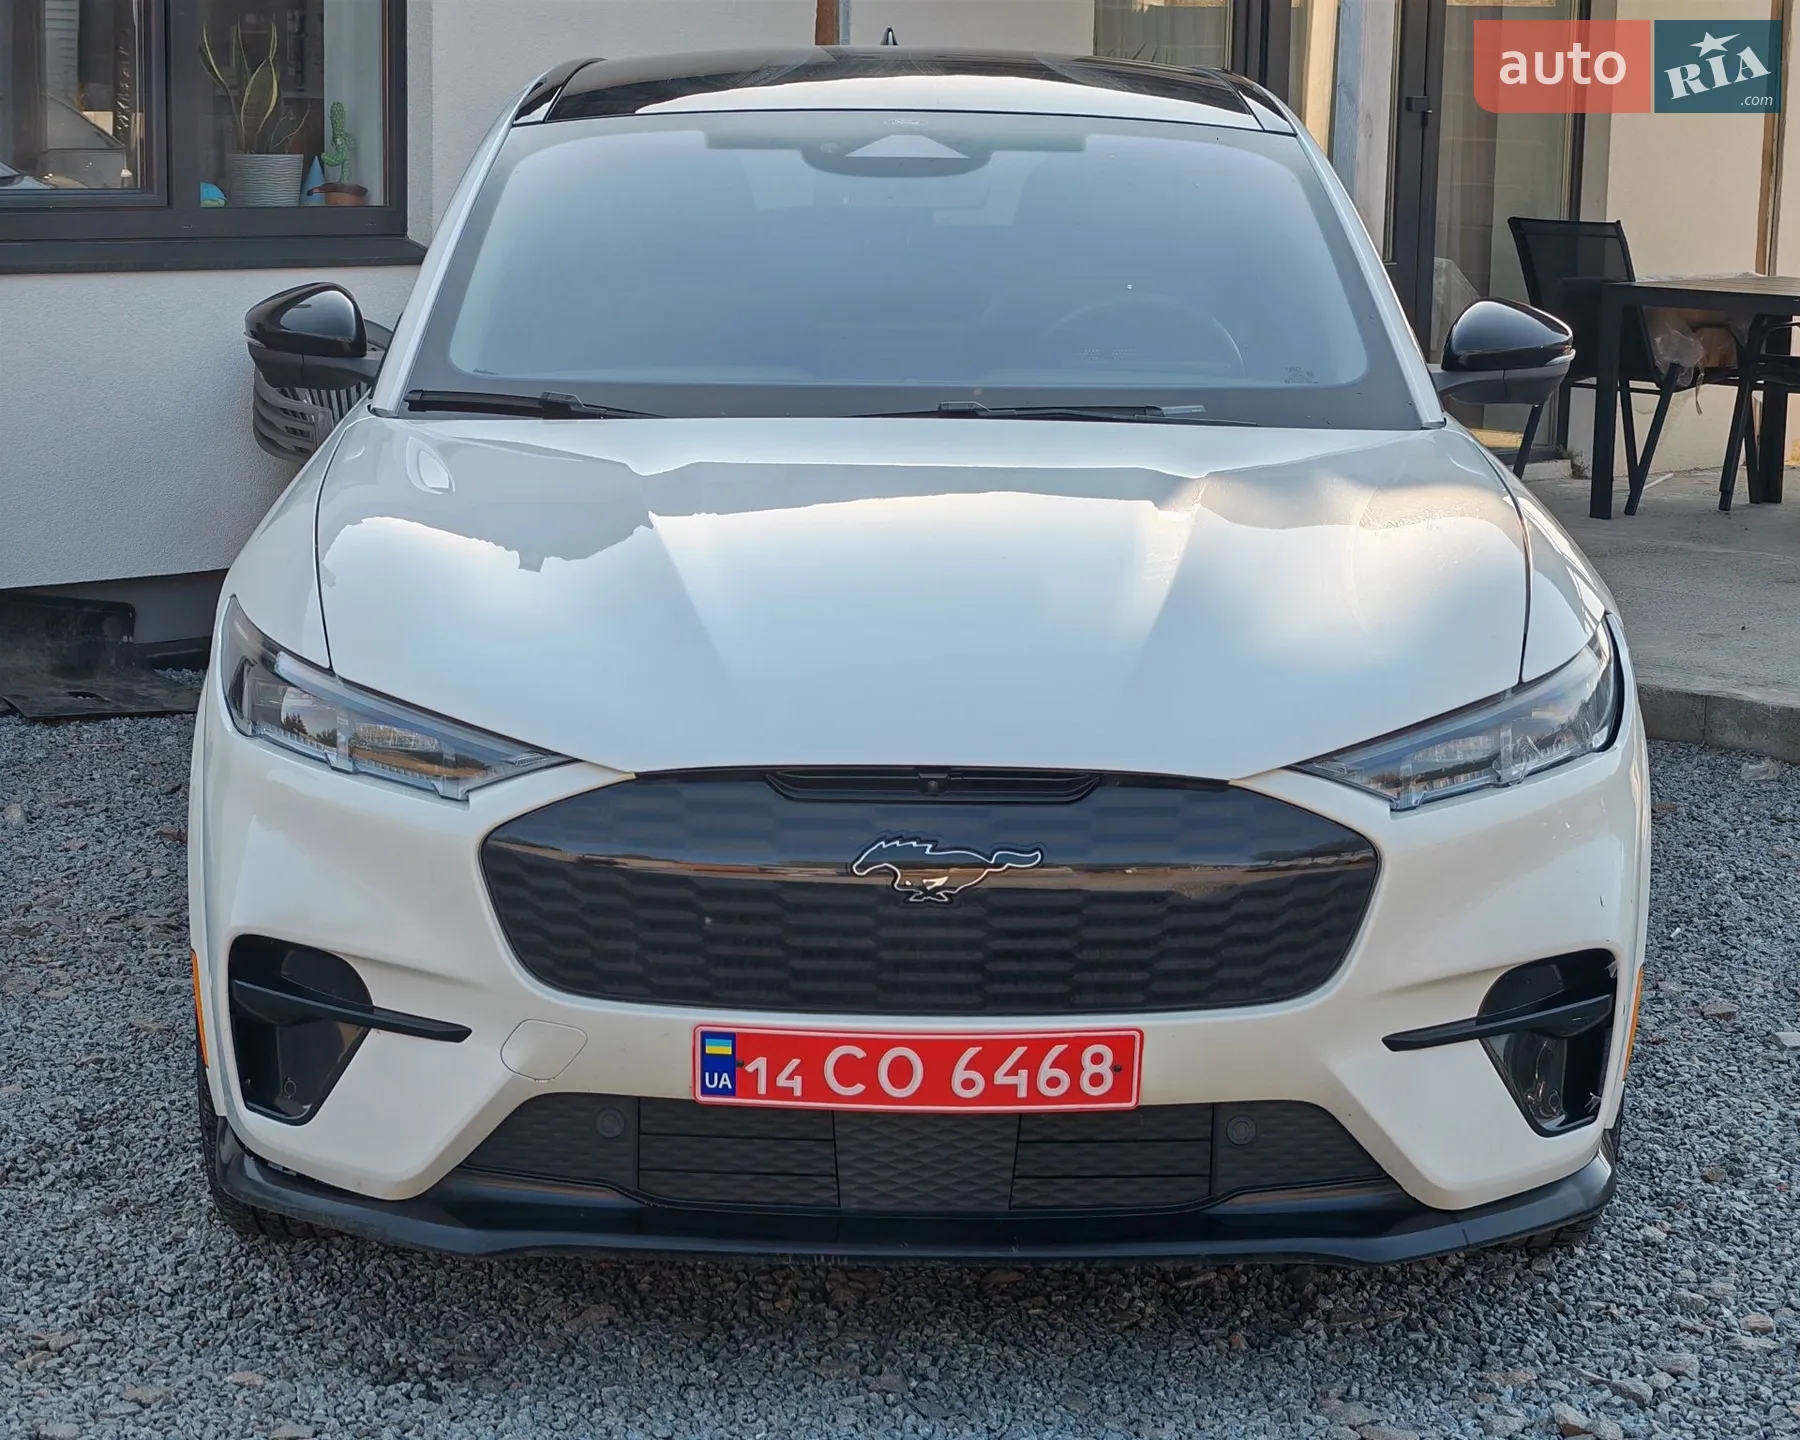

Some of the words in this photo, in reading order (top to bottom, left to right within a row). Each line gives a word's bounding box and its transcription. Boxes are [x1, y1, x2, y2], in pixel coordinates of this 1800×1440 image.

[705, 1072, 732, 1089] UA
[744, 1057, 802, 1097] 14
[823, 1045, 924, 1099] CO
[951, 1044, 1114, 1099] 6468
